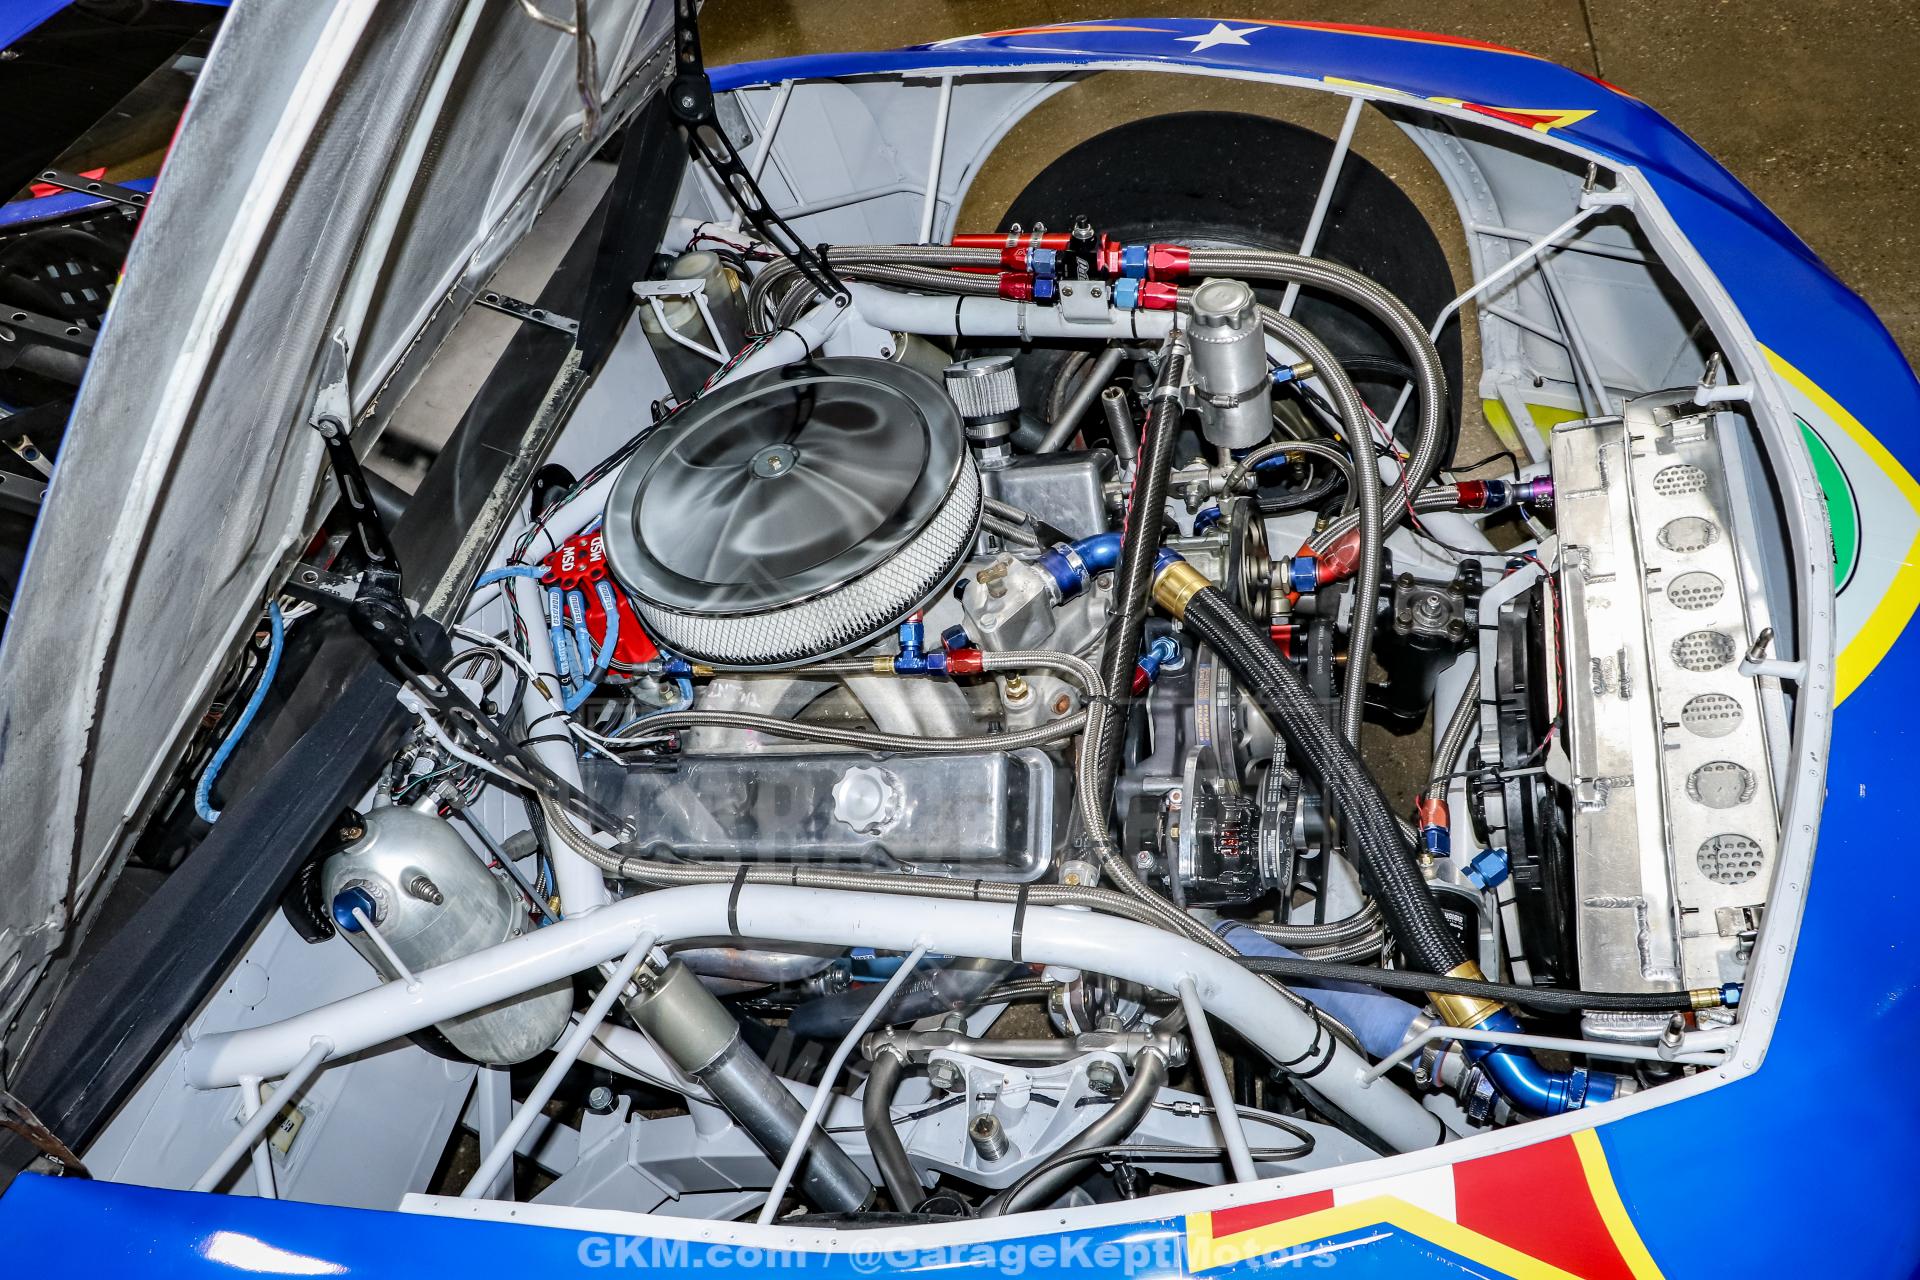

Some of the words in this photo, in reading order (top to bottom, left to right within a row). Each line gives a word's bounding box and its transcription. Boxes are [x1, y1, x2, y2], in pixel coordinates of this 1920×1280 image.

[562, 546, 575, 571] MSD
[590, 537, 602, 562] MSD
[551, 592, 560, 626] MOROSO
